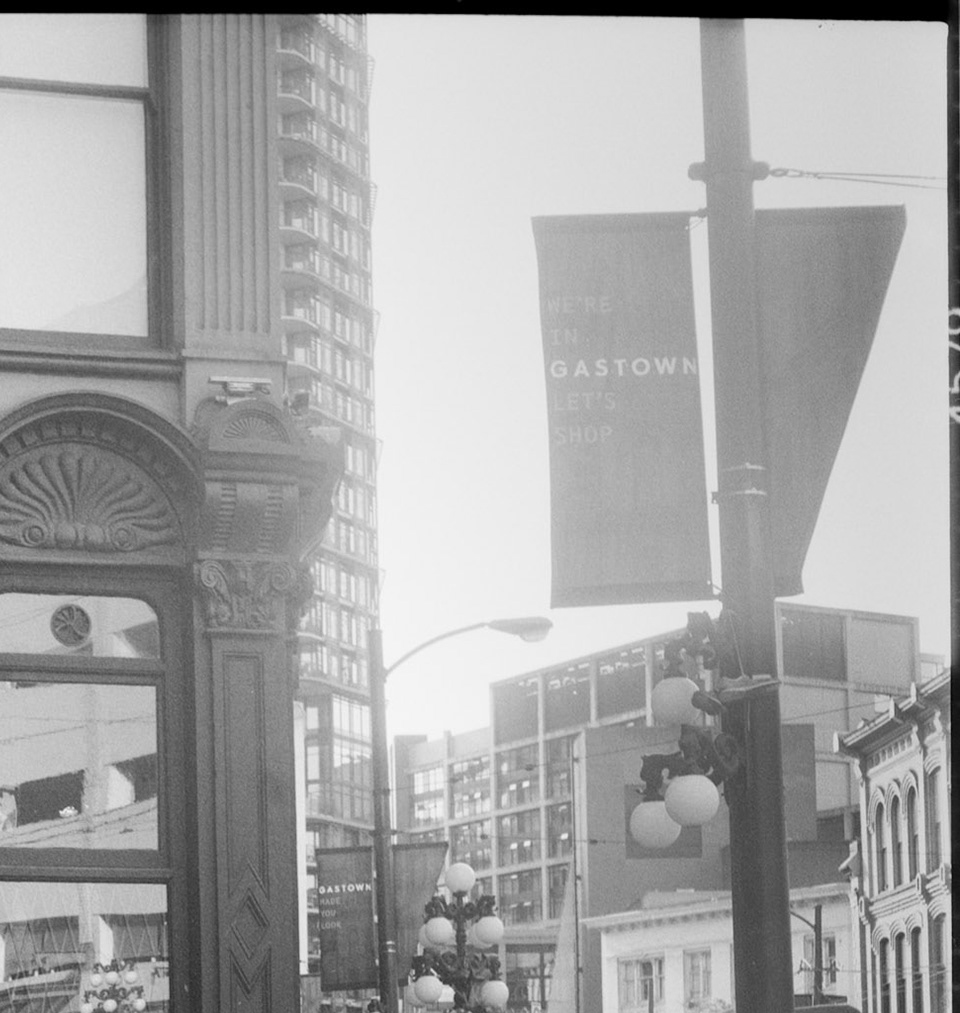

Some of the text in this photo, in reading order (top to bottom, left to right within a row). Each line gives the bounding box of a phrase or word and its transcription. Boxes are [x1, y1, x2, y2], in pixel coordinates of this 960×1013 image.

[547, 296, 613, 314] WE'RE
[551, 328, 578, 346] IN
[550, 356, 697, 378] GASTOWN
[554, 391, 616, 411] LET'S
[555, 425, 614, 444] SHOP
[318, 883, 372, 894] GASTOWN
[321, 921, 342, 930] LOOK
